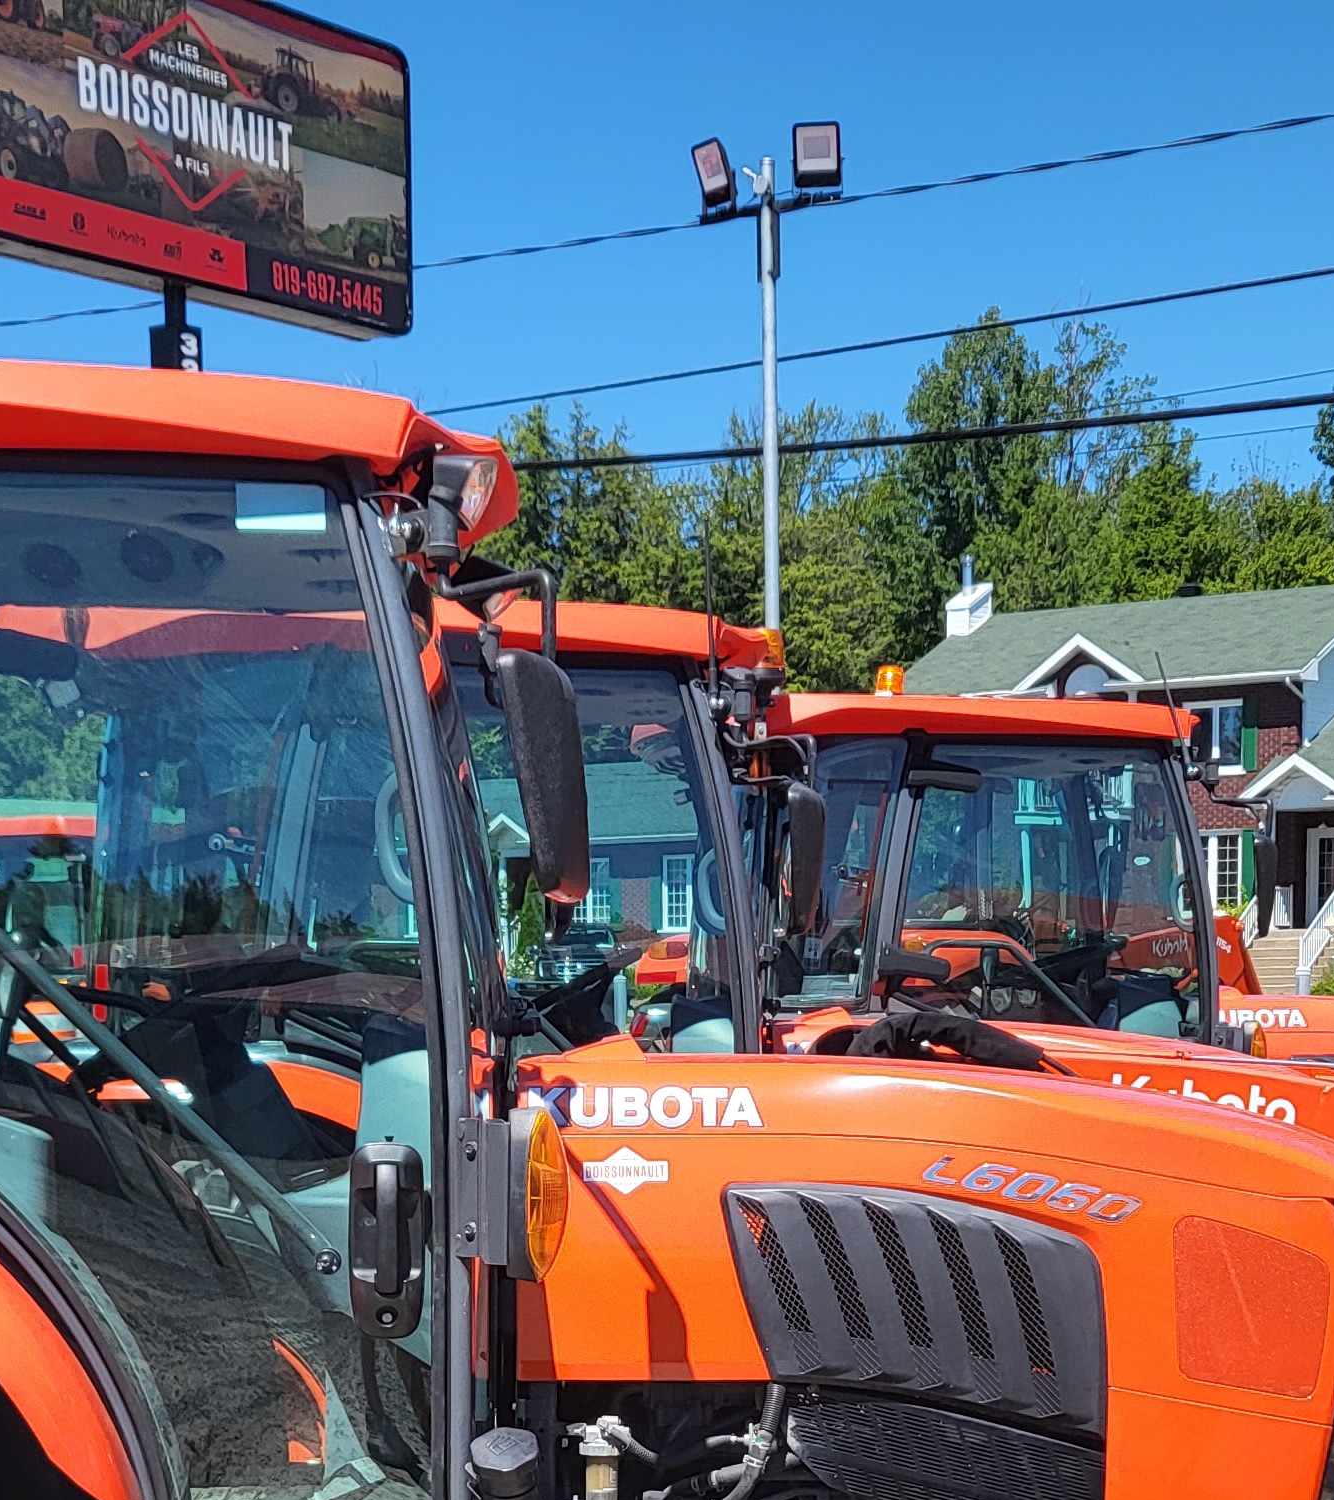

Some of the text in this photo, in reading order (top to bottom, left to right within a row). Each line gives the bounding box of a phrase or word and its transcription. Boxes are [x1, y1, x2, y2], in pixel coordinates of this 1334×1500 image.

[148, 48, 228, 88] MACHINERIES
[177, 41, 200, 62] LES
[77, 56, 293, 172] BOISSONNAULT
[185, 157, 209, 177] FILS
[106, 224, 146, 247] Kubota
[272, 261, 383, 316] 819-697-5445
[1219, 1009, 1307, 1028] UBOTA
[527, 1085, 765, 1129] KUBOTA
[1112, 1074, 1296, 1126] bta
[585, 1164, 665, 1179] BOISSONNAULT
[921, 1154, 1143, 1224] L6060
